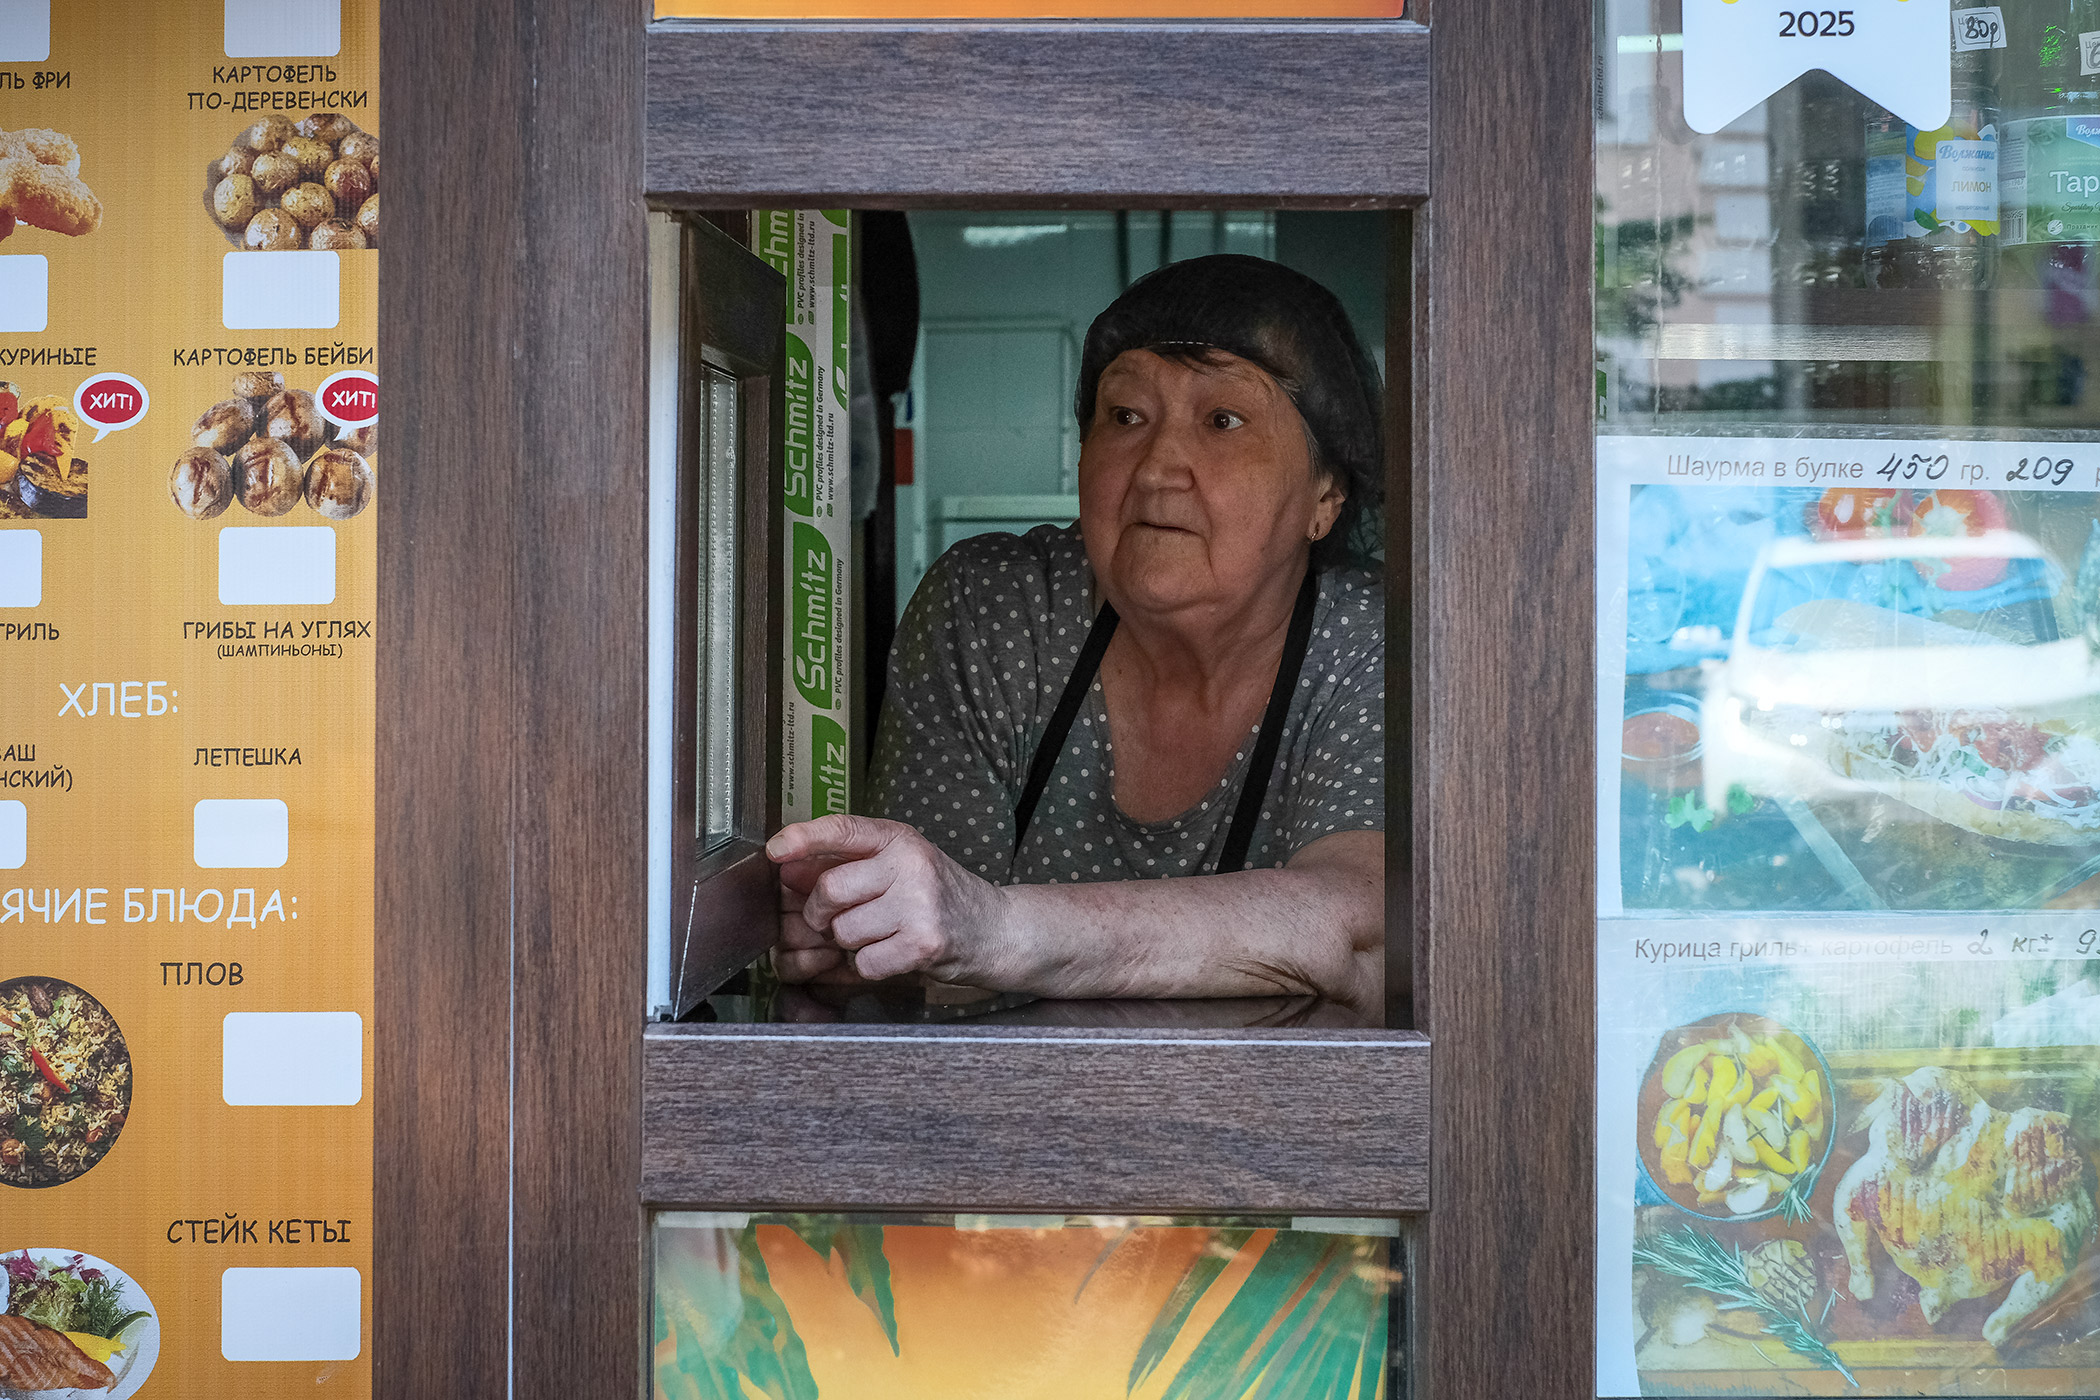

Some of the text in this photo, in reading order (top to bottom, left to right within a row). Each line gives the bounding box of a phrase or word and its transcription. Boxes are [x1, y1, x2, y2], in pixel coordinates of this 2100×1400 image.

[1778, 10, 1855, 37] 2025
[32, 71, 70, 90] ФРИ
[213, 65, 337, 84] КАРТОФЕЛЬ
[187, 90, 368, 112] ПО-ДЕРЕВЕНСКИ
[1951, 181, 1992, 193] ЛИМОН
[798, 213, 805, 221] in
[797, 223, 806, 259] designed
[797, 260, 806, 290] profiles
[807, 220, 815, 308] www.schmitz-ltd.ru
[173, 342, 374, 366] КАРТОФЕЛЬ БЕЙБИ
[331, 390, 376, 409] ХИТ!
[816, 366, 825, 403] Germany
[89, 392, 134, 410] ХИТ!
[815, 405, 823, 413] in
[784, 357, 807, 498] Schmitz
[815, 414, 825, 451] designed
[816, 452, 825, 483] profiles
[826, 413, 834, 501] www.schmitz-ltd.ru
[1667, 455, 1765, 481] Шаурма
[1774, 461, 1786, 477] в
[1795, 456, 1864, 483] булке
[1877, 452, 1949, 482] 450
[1961, 463, 1990, 485] гр.
[2006, 456, 2074, 486] 209
[183, 621, 372, 640] ГРИБЫ НА УГЛЯХ
[798, 549, 826, 690] Schmitz
[834, 558, 844, 694] PVC profiles designed in Germany
[217, 643, 343, 660] (ШАМПИНЬОНЫ)
[58, 681, 179, 718] ХЛЕБ:
[193, 748, 302, 767] ЛЕПЕШКА
[786, 702, 794, 790] www.schmitz-ltd.ru
[124, 888, 298, 929] БЛЮДА:
[1635, 938, 1721, 963] Курица
[1821, 936, 1952, 960] картофель
[1967, 928, 1994, 956] 2
[160, 962, 244, 986] ПЛОВ
[167, 1212, 352, 1244] СТЕЙК КЕТЫ
